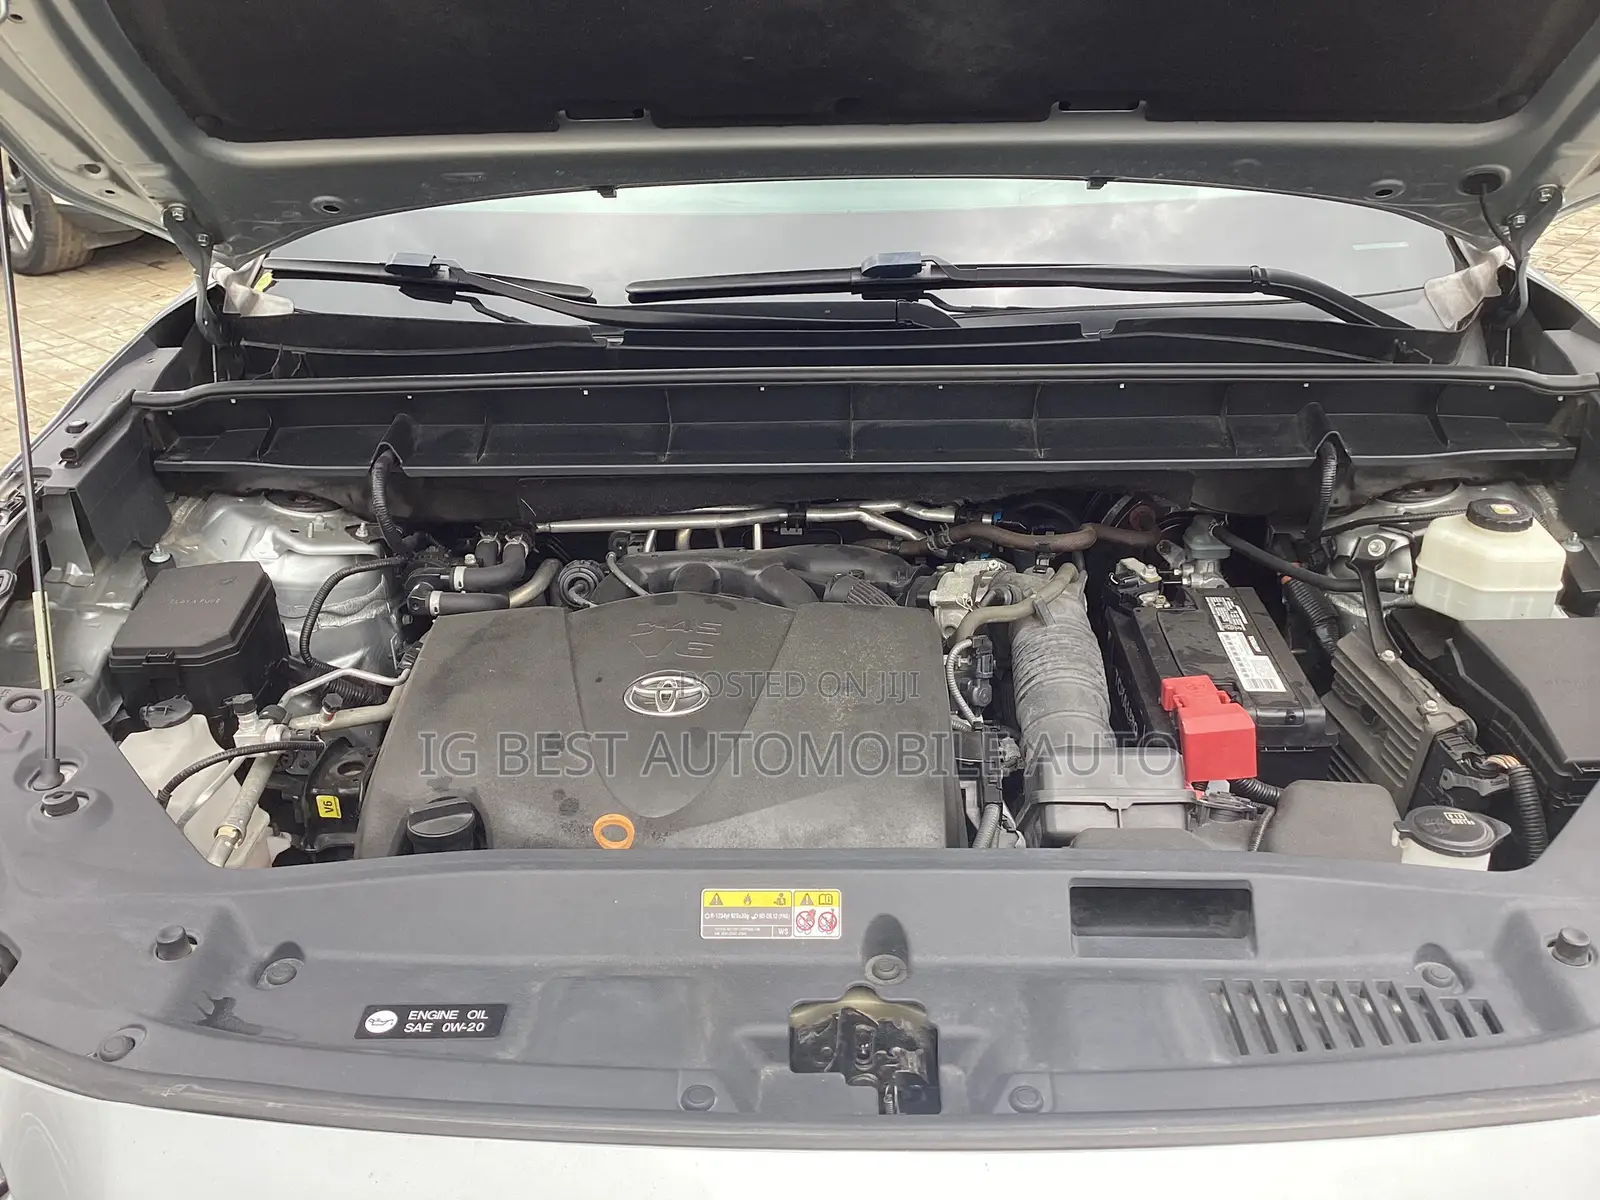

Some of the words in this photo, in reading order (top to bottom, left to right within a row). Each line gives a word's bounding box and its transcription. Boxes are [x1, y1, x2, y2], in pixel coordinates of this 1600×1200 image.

[323, 801, 334, 813] V6
[777, 927, 789, 936] WS
[408, 1010, 460, 1020] ENGINE
[466, 1009, 489, 1020] OIL
[403, 1022, 434, 1033] SAE
[441, 1022, 485, 1032] 0W-20
